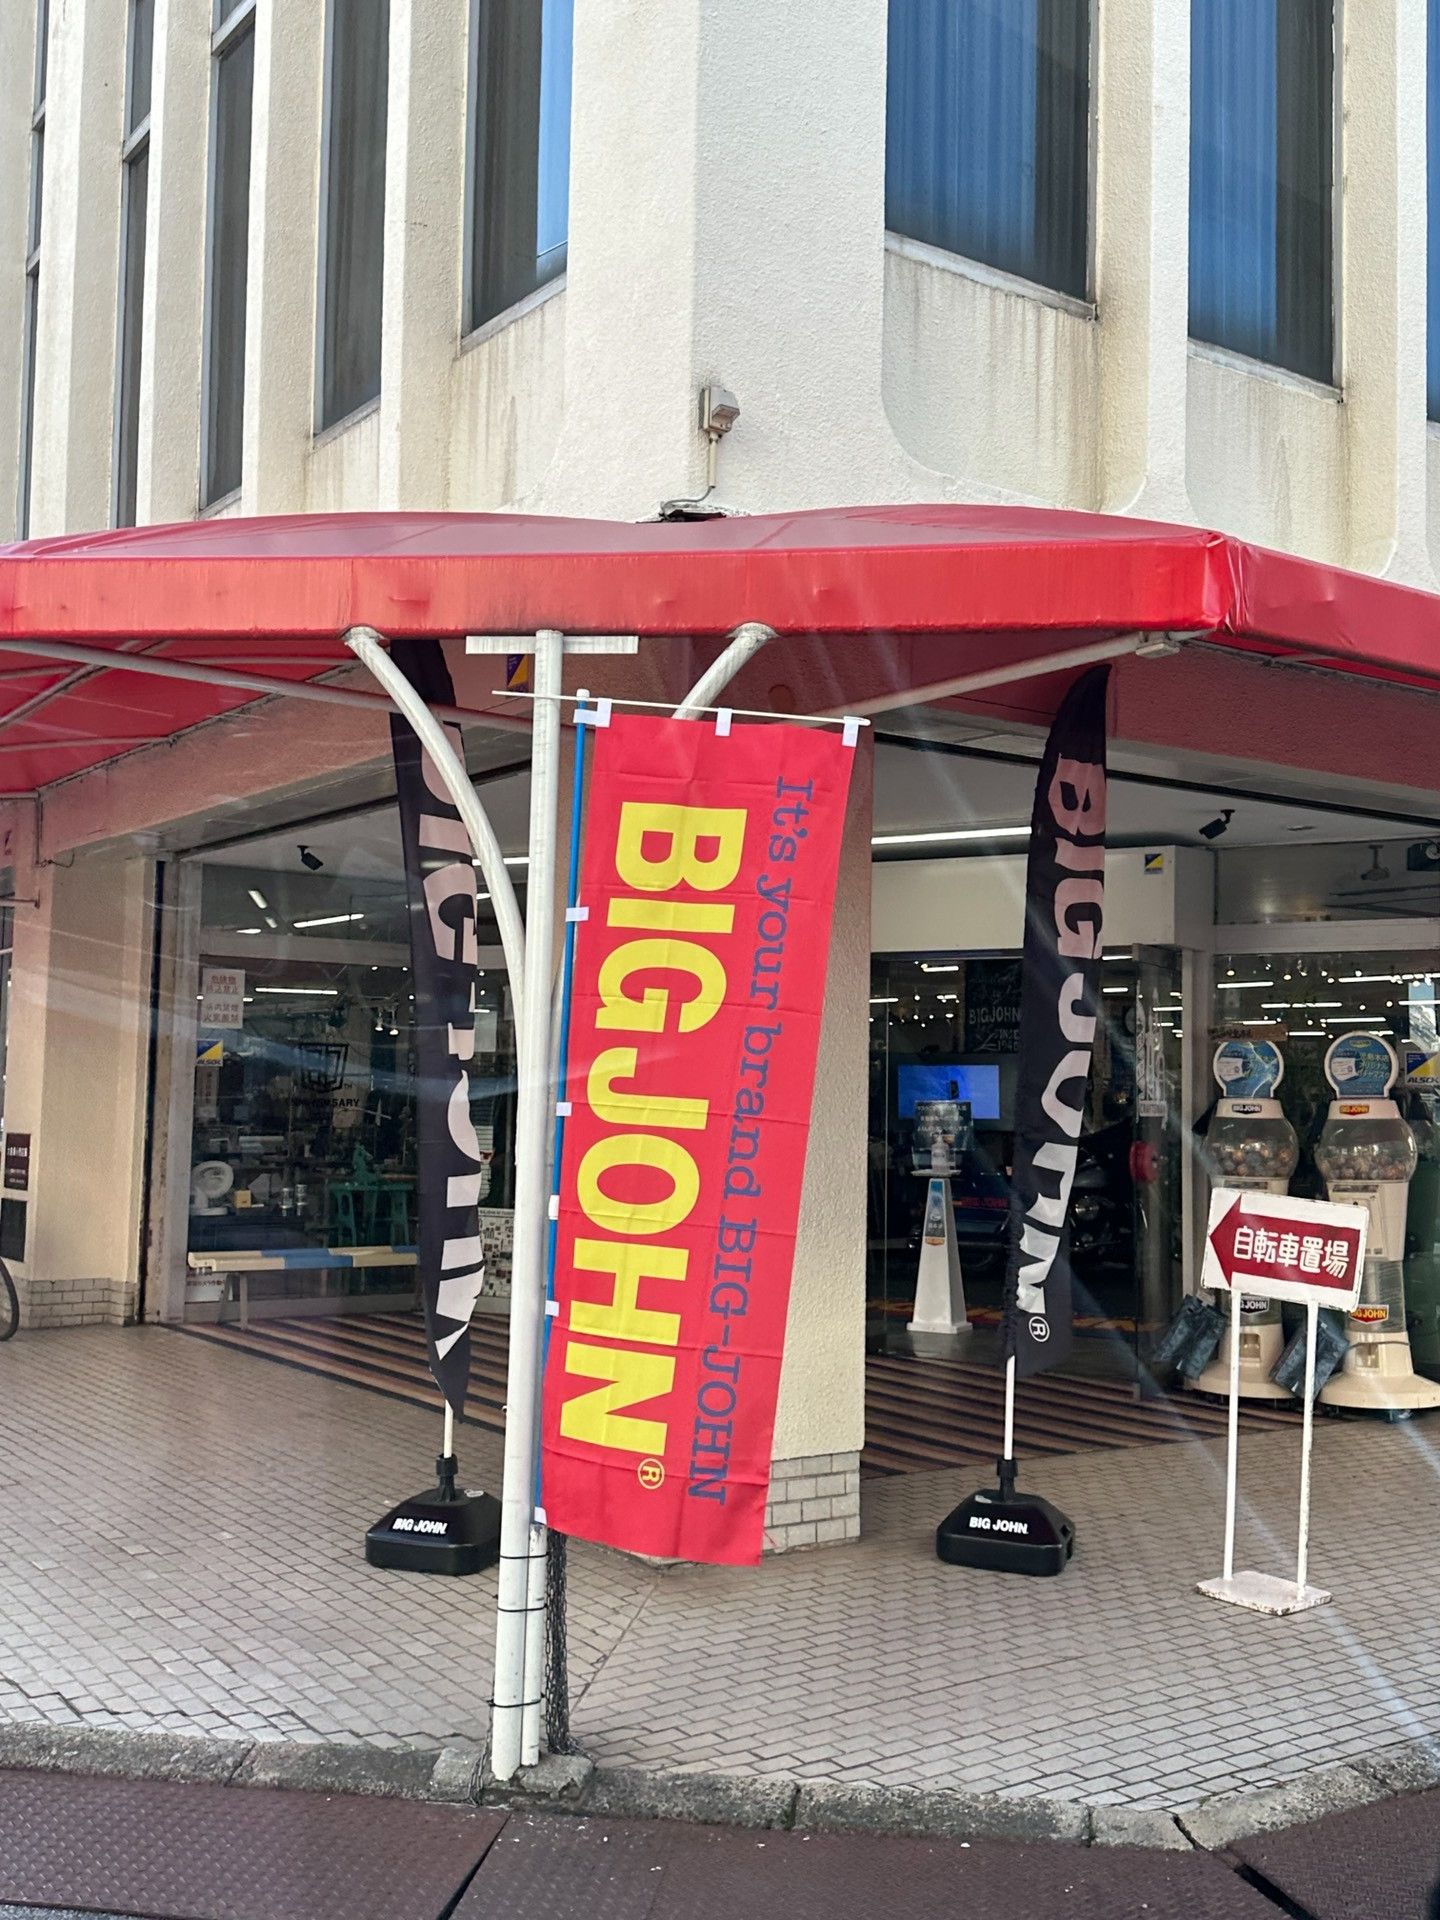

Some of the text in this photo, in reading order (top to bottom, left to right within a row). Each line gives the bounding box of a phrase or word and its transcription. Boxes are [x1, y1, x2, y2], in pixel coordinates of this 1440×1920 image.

[688, 776, 813, 1505] It's your brand BIG-JOHN
[1234, 1225, 1350, 1279] 自転車置場
[969, 1516, 1028, 1535] BIG JOHN
